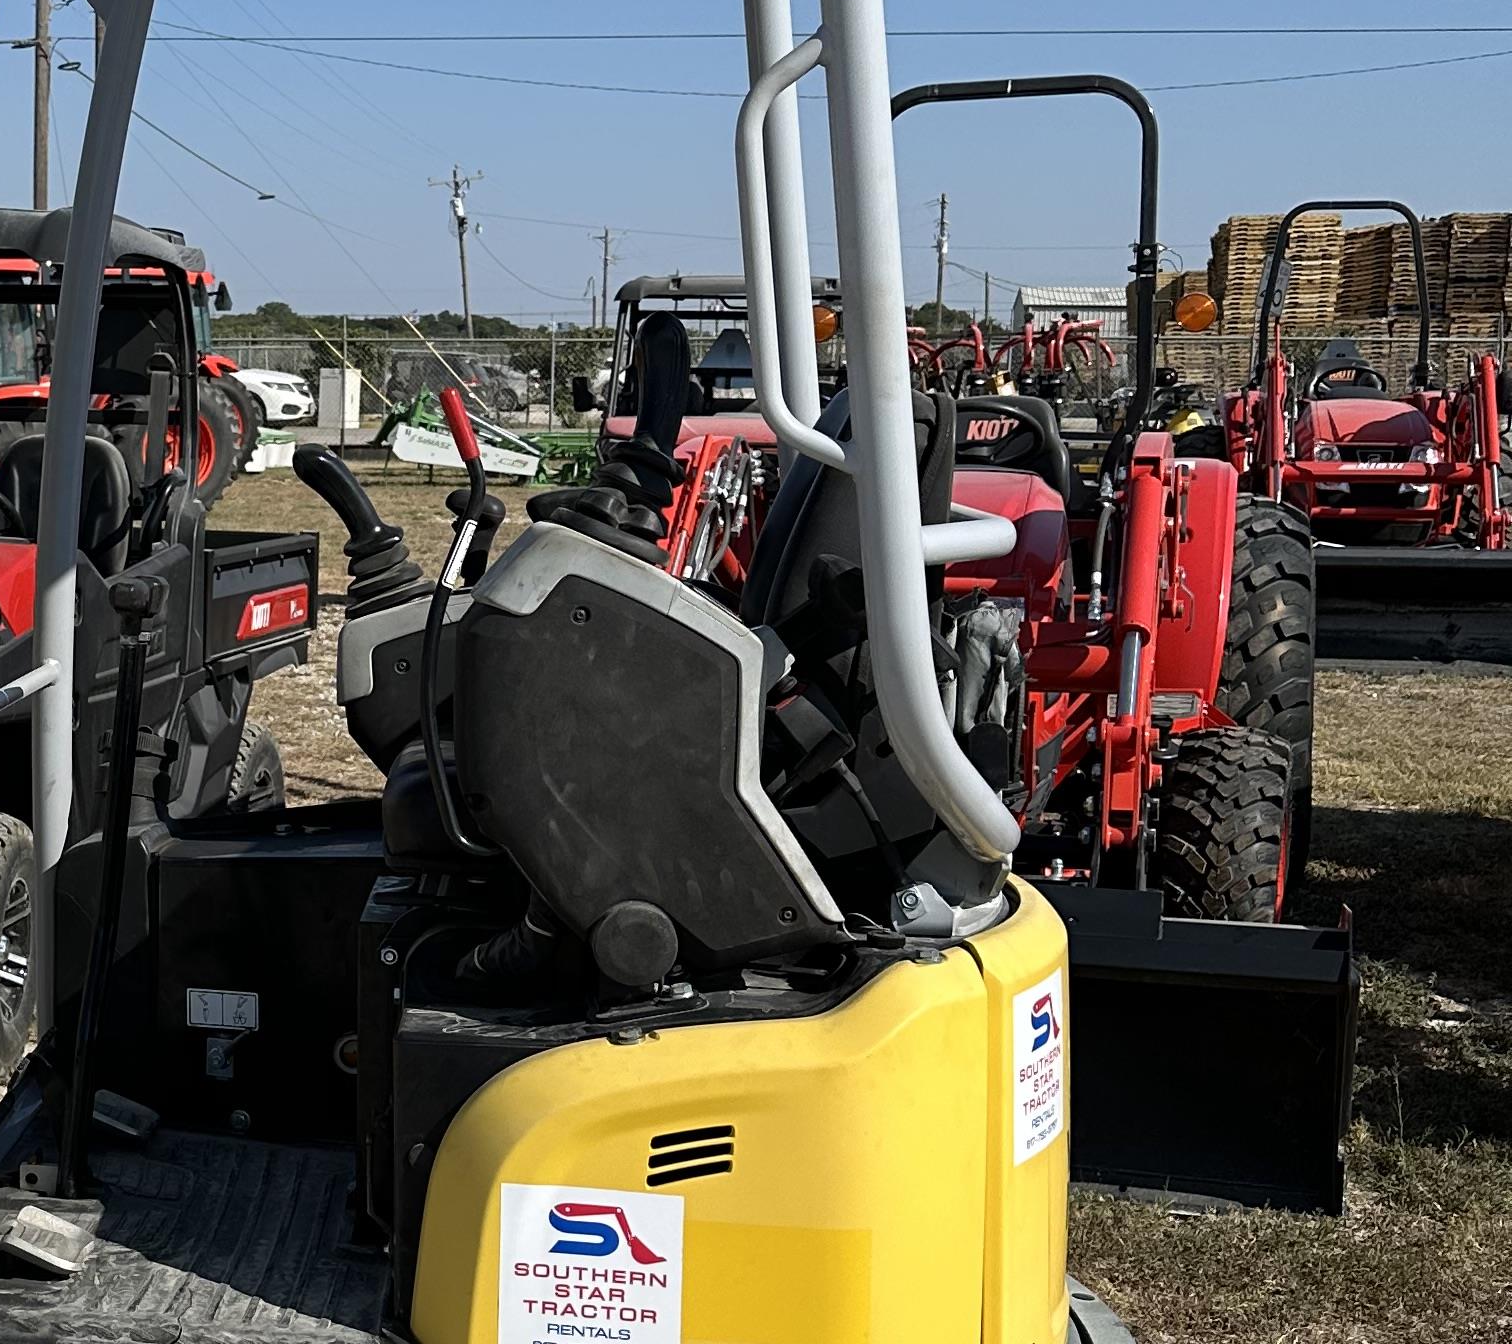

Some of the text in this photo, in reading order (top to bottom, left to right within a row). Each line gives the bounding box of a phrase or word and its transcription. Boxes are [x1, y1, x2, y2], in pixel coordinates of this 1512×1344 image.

[1033, 1068, 1054, 1093] STAR
[514, 1262, 667, 1288] SOUTHERN
[554, 1284, 625, 1303] STAR
[523, 1299, 657, 1324] TRACTOR
[547, 1323, 631, 1341] RENTALS
